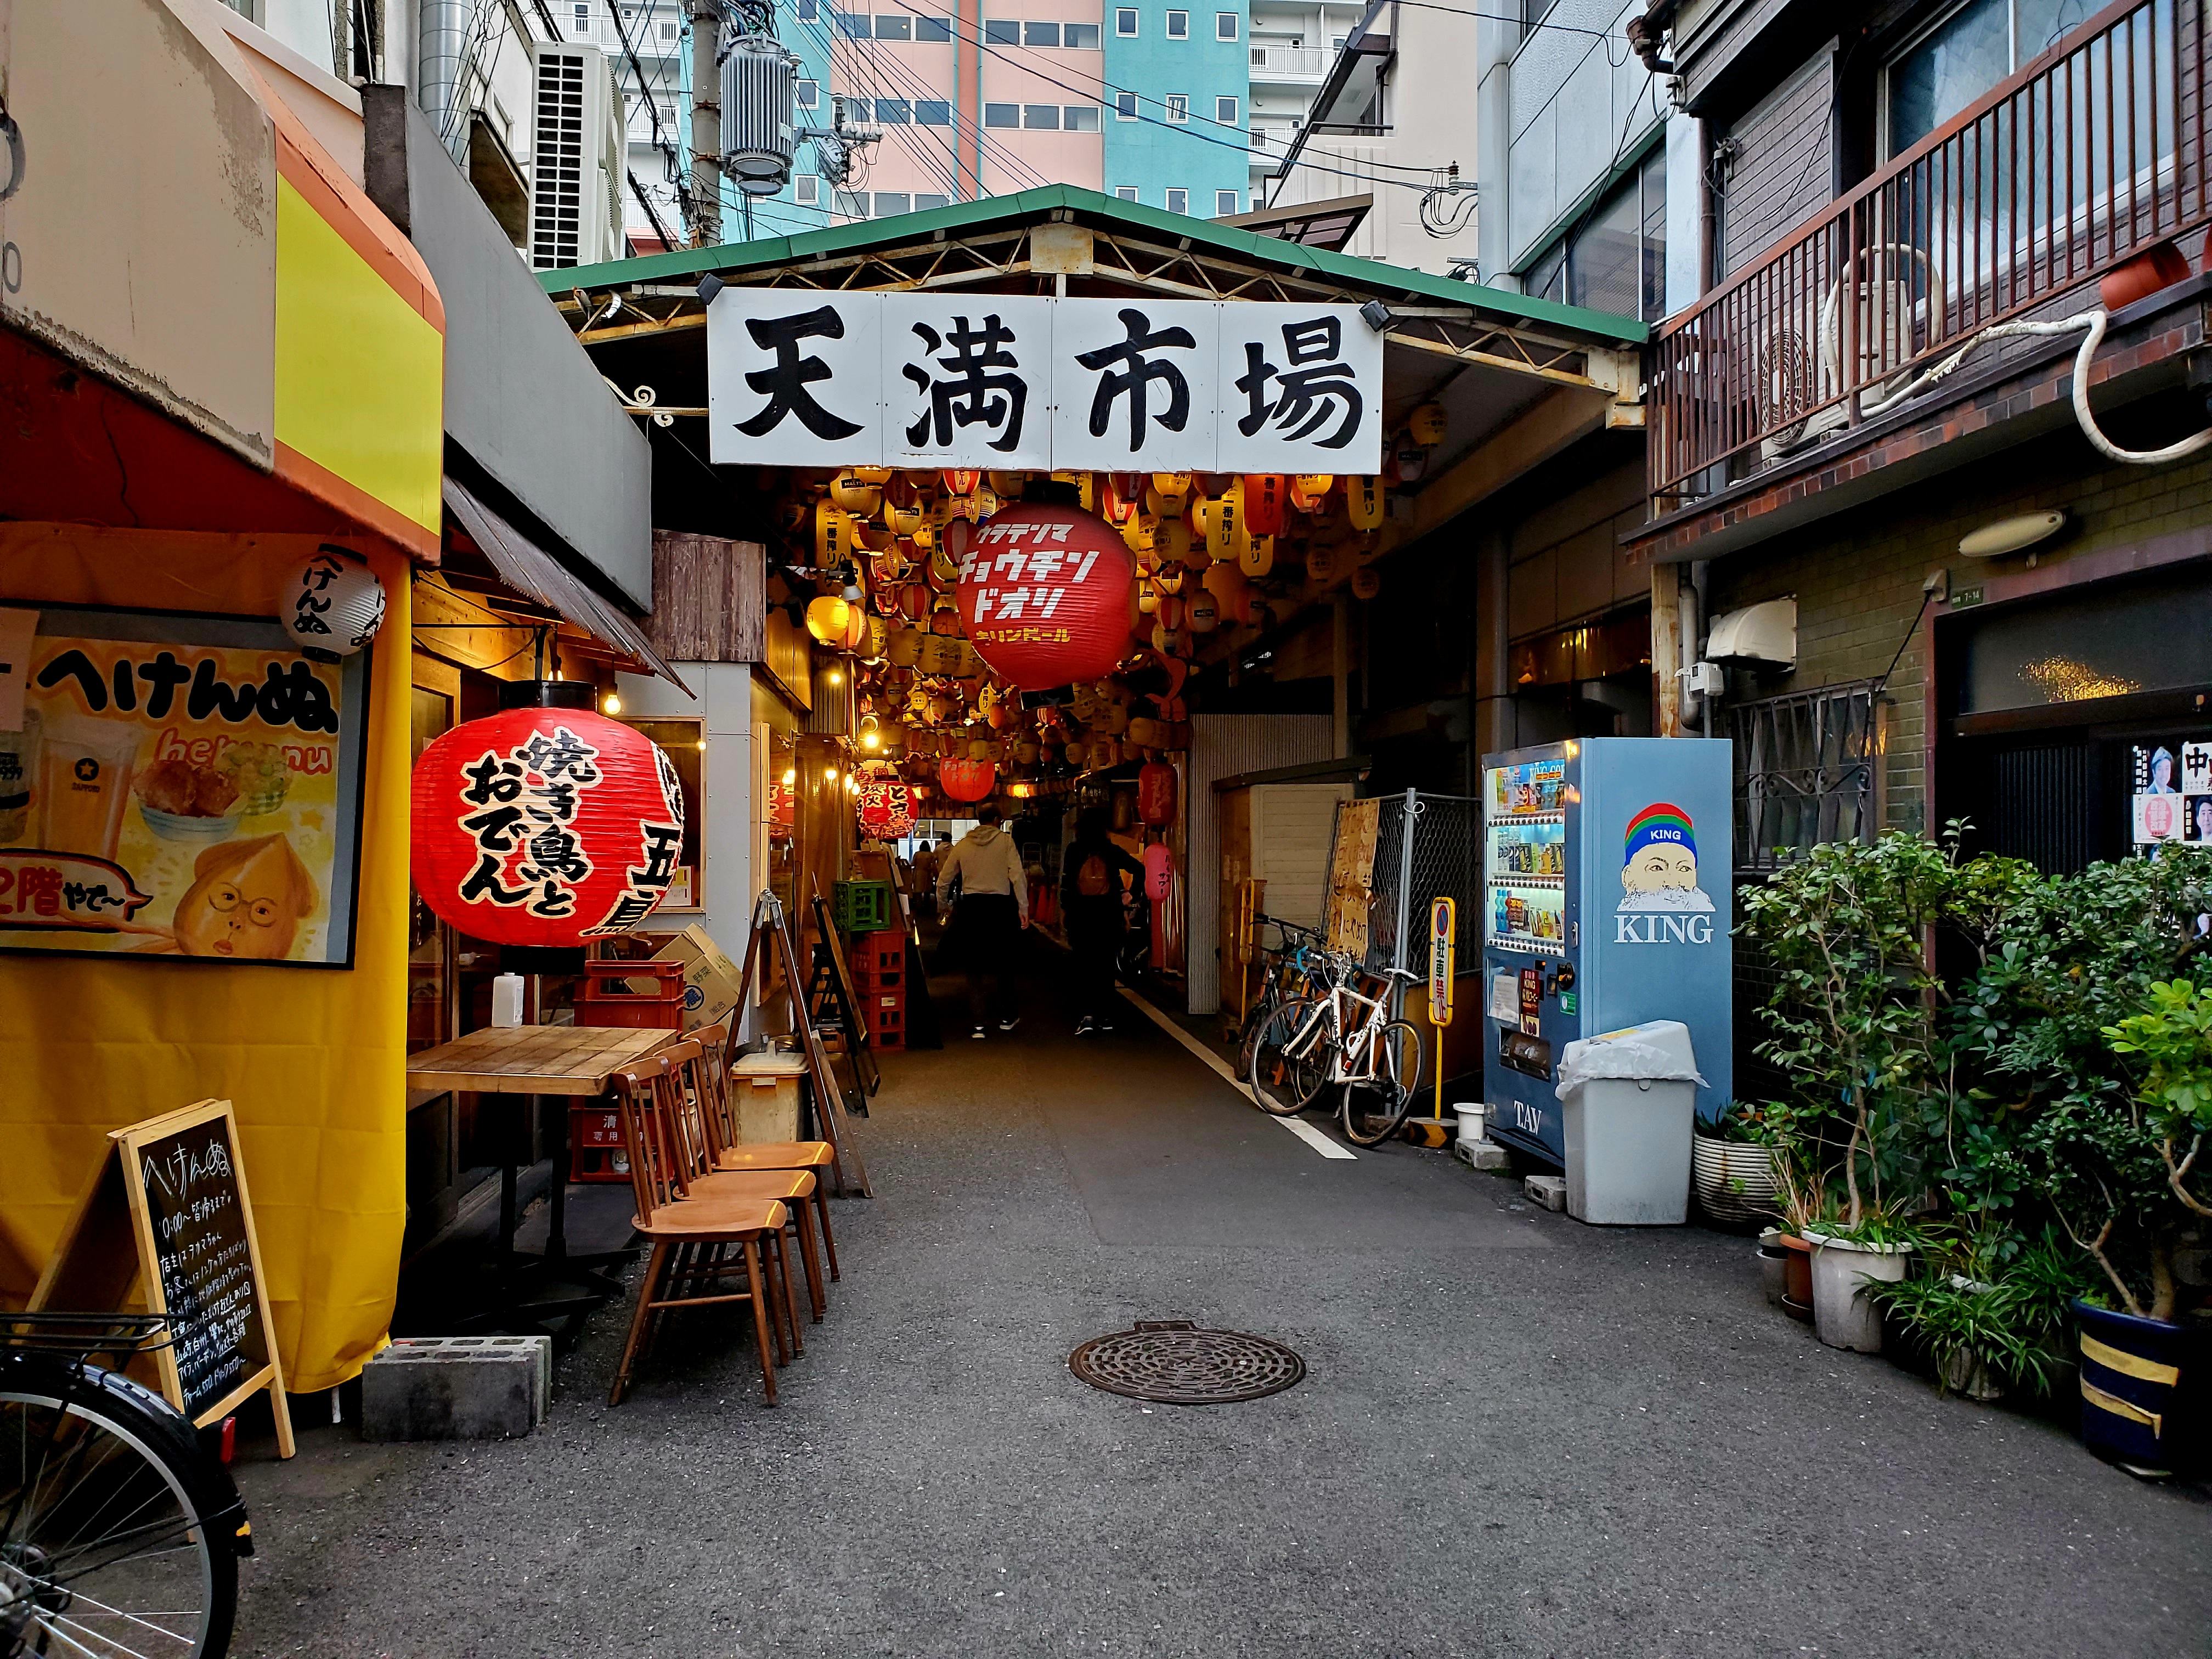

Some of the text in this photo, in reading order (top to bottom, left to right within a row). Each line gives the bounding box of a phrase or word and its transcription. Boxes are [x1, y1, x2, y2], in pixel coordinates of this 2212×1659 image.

[732, 306, 1364, 453] 天満市場
[826, 522, 838, 564] 一番搾り
[1222, 500, 1234, 545] 一番搾り
[959, 549, 1100, 584] チョウチン
[293, 555, 344, 635] へけんぬ
[974, 586, 1065, 623] ドオリ
[975, 627, 1070, 642] キリンビール
[38, 649, 339, 734] へけんぬ
[461, 753, 534, 906] おでん
[514, 727, 601, 917] 焼き鳥と
[1650, 830, 1681, 840] KING
[1613, 915, 1714, 944] KING
[692, 966, 712, 984] 野菜
[1436, 937, 1447, 1023] 駐車禁止
[1524, 979, 1536, 989] KING
